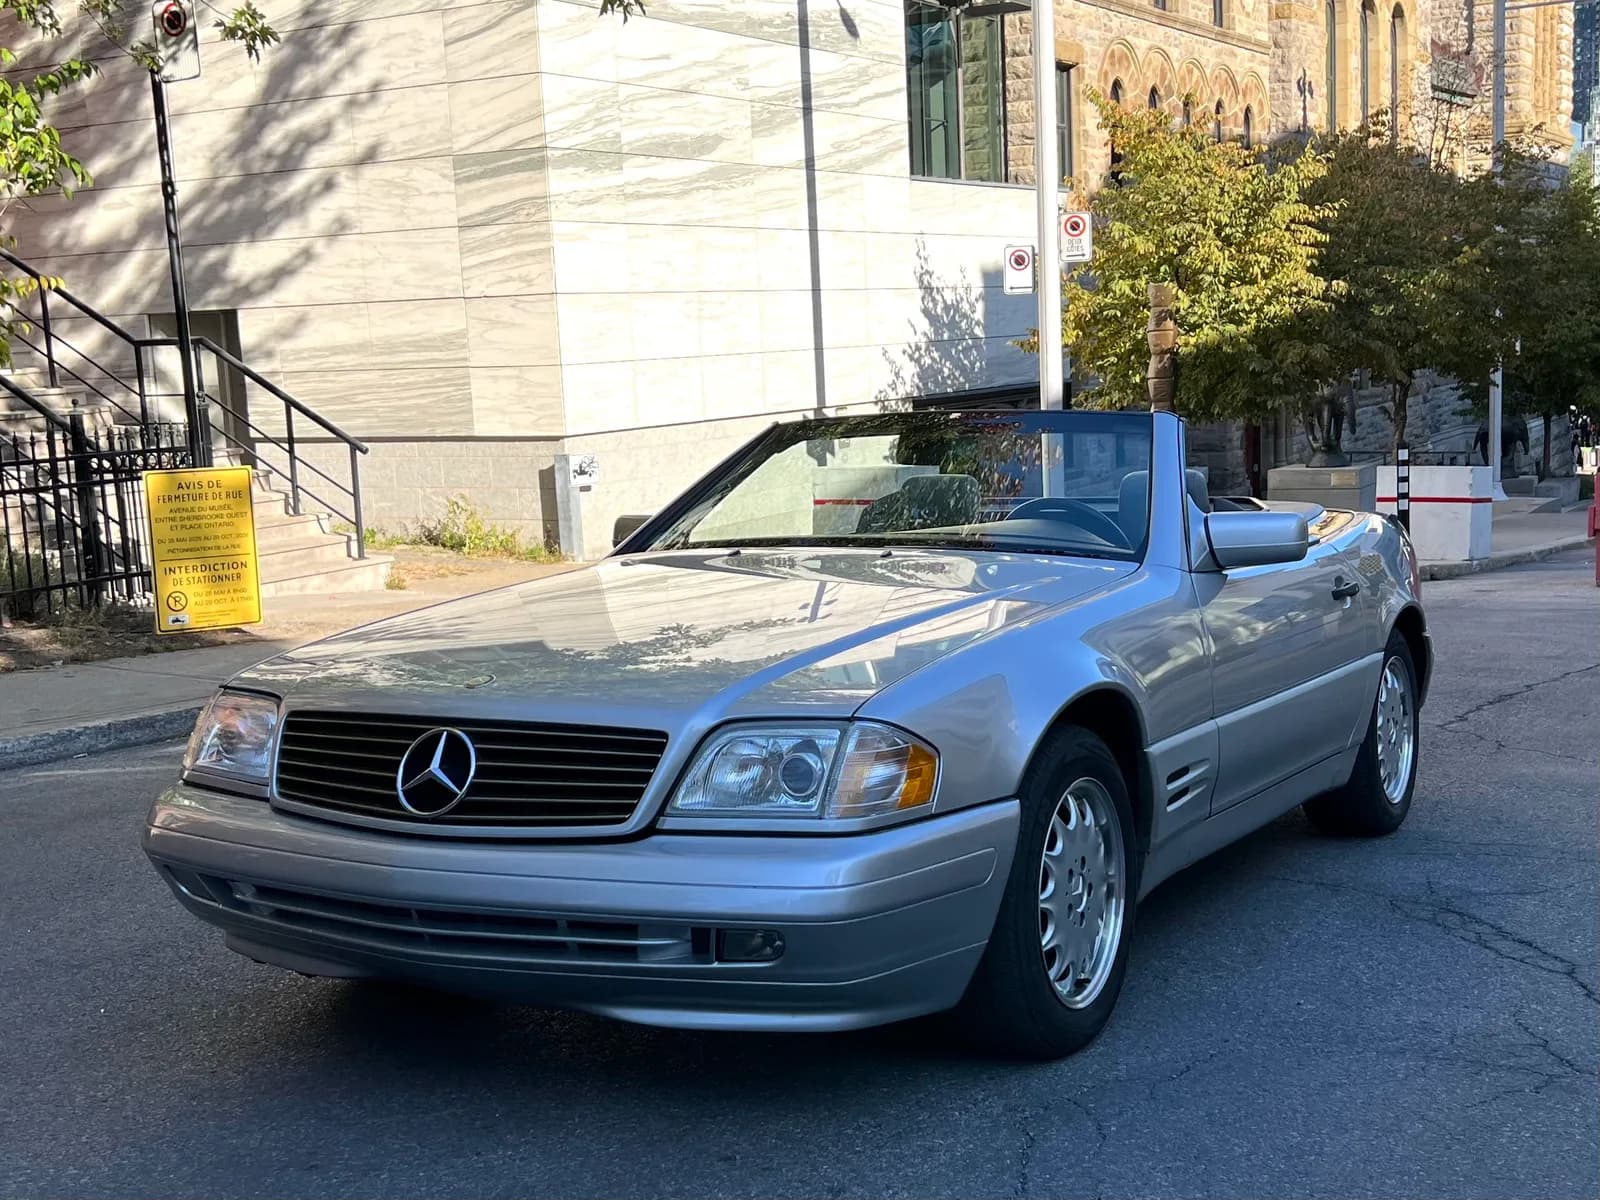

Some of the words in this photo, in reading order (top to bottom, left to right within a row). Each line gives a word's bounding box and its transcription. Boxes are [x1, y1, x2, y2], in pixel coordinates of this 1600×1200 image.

[177, 480, 204, 490] AVIS
[208, 480, 222, 489] DE
[157, 492, 209, 504] FERMETURE
[212, 492, 223, 500] DE
[226, 491, 243, 499] RUE
[169, 506, 196, 514] AVENUE
[155, 515, 178, 524] ENTRE
[179, 514, 224, 522] SHERBROOKE
[180, 522, 203, 530] PLACE
[164, 561, 248, 576] INTERDICTION
[172, 578, 184, 586] DE
[186, 573, 241, 585] STATIONNER
